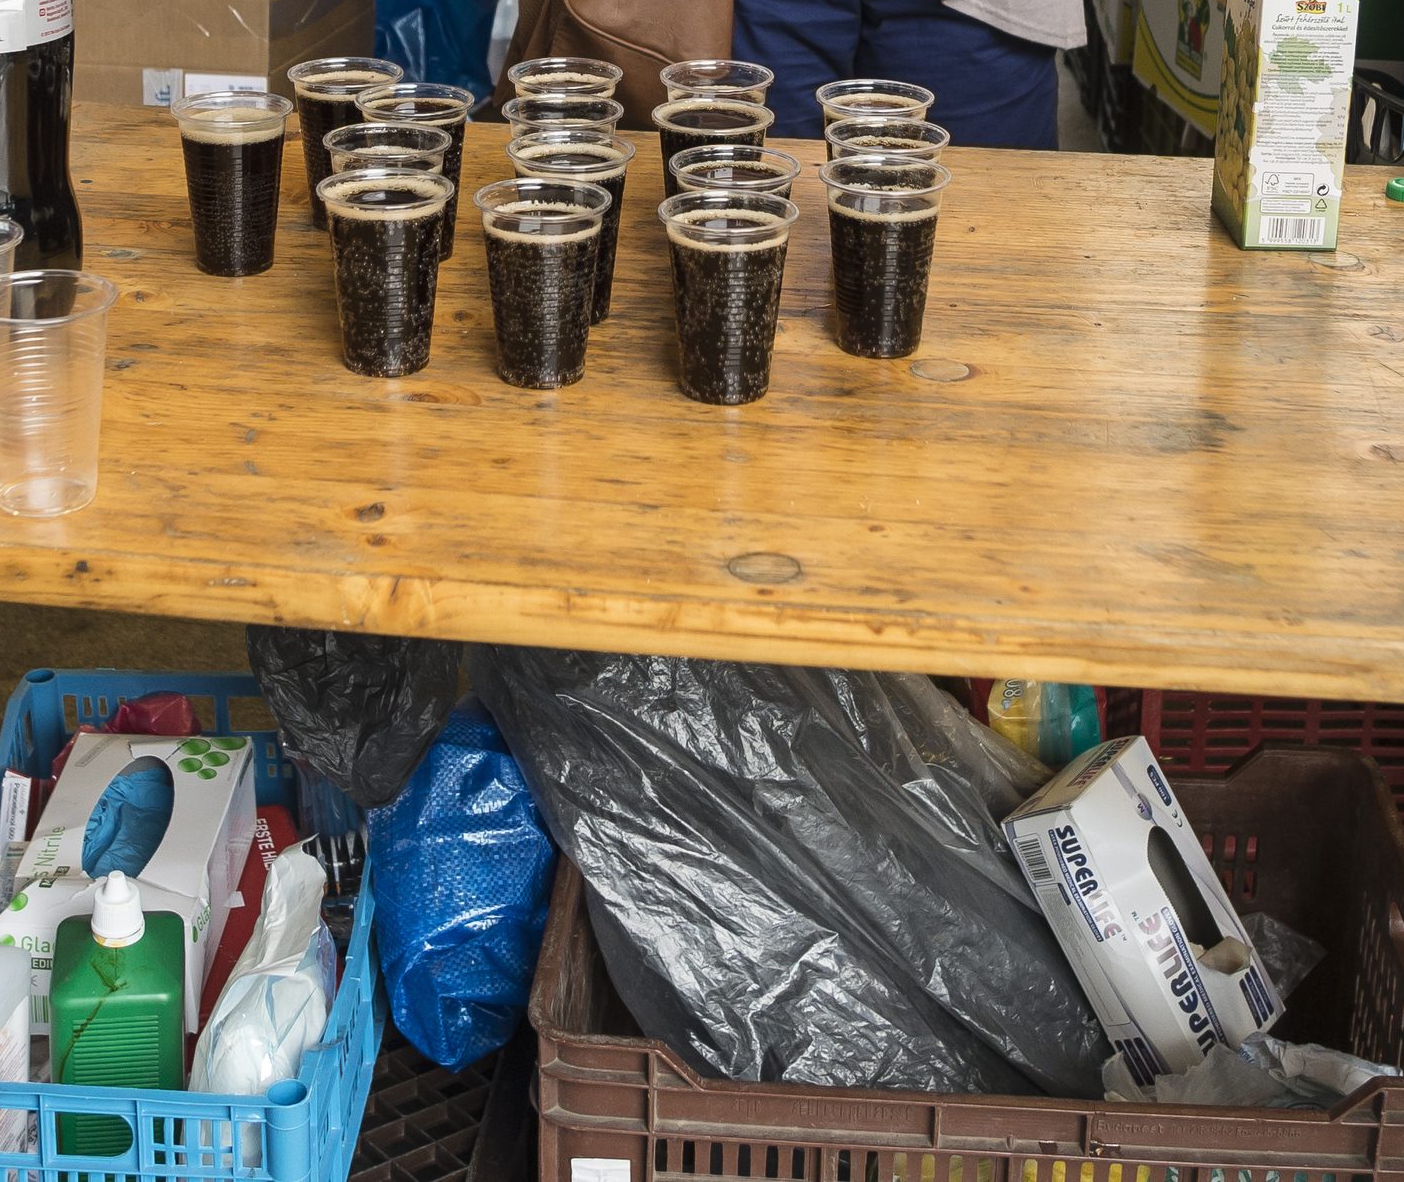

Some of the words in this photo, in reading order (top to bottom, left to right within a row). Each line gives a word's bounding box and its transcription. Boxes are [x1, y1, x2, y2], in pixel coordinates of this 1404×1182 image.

[1296, 3, 1327, 13] SZOBI
[34, 826, 65, 867] Nitrile
[256, 817, 274, 852] ERSTE
[1054, 824, 1122, 940] SUPERLIFE
[1162, 907, 1179, 933] GLOVES
[1173, 931, 1197, 975] EXAMINATION
[1140, 912, 1214, 1058] UPERLIFE
